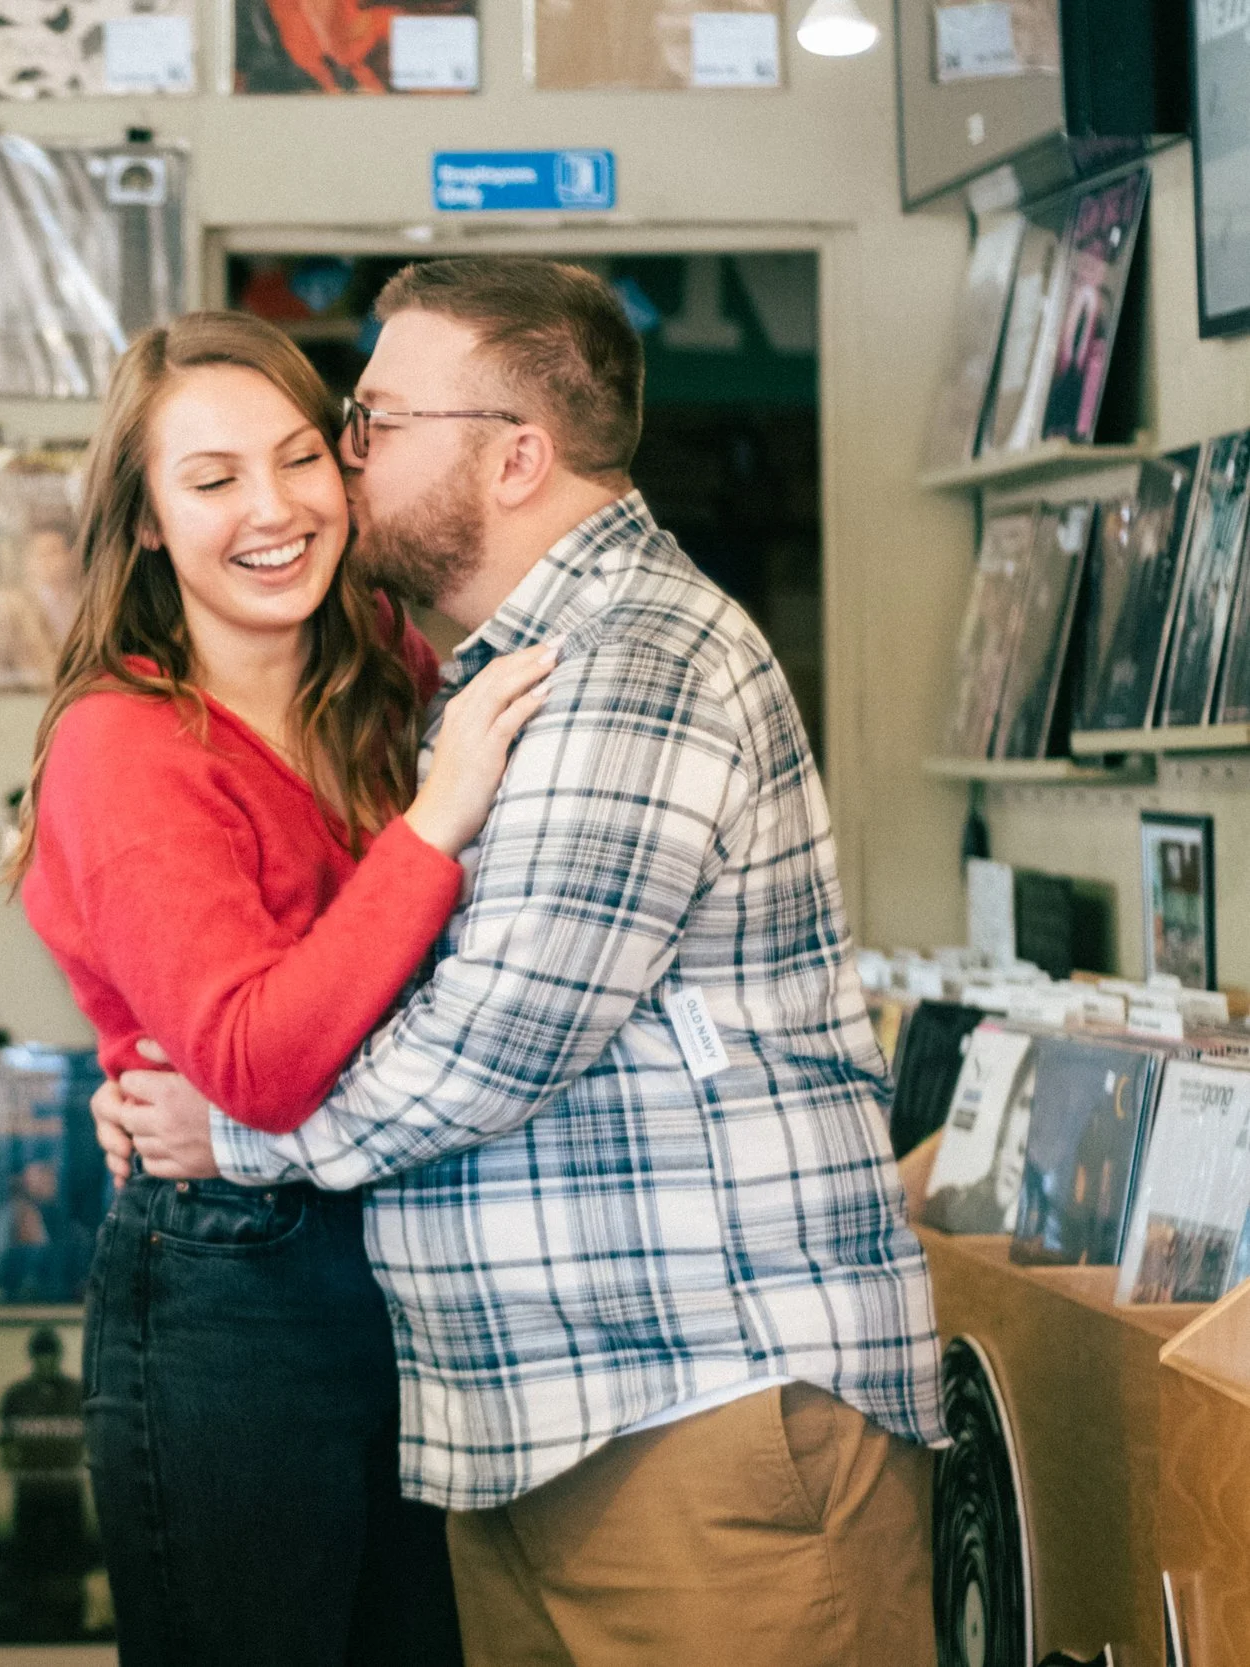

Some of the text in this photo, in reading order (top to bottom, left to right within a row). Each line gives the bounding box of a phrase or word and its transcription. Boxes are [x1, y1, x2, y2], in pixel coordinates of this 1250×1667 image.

[686, 999, 703, 1025] OLD
[697, 1024, 719, 1058] NAVY
[1200, 1084, 1235, 1116] gong
